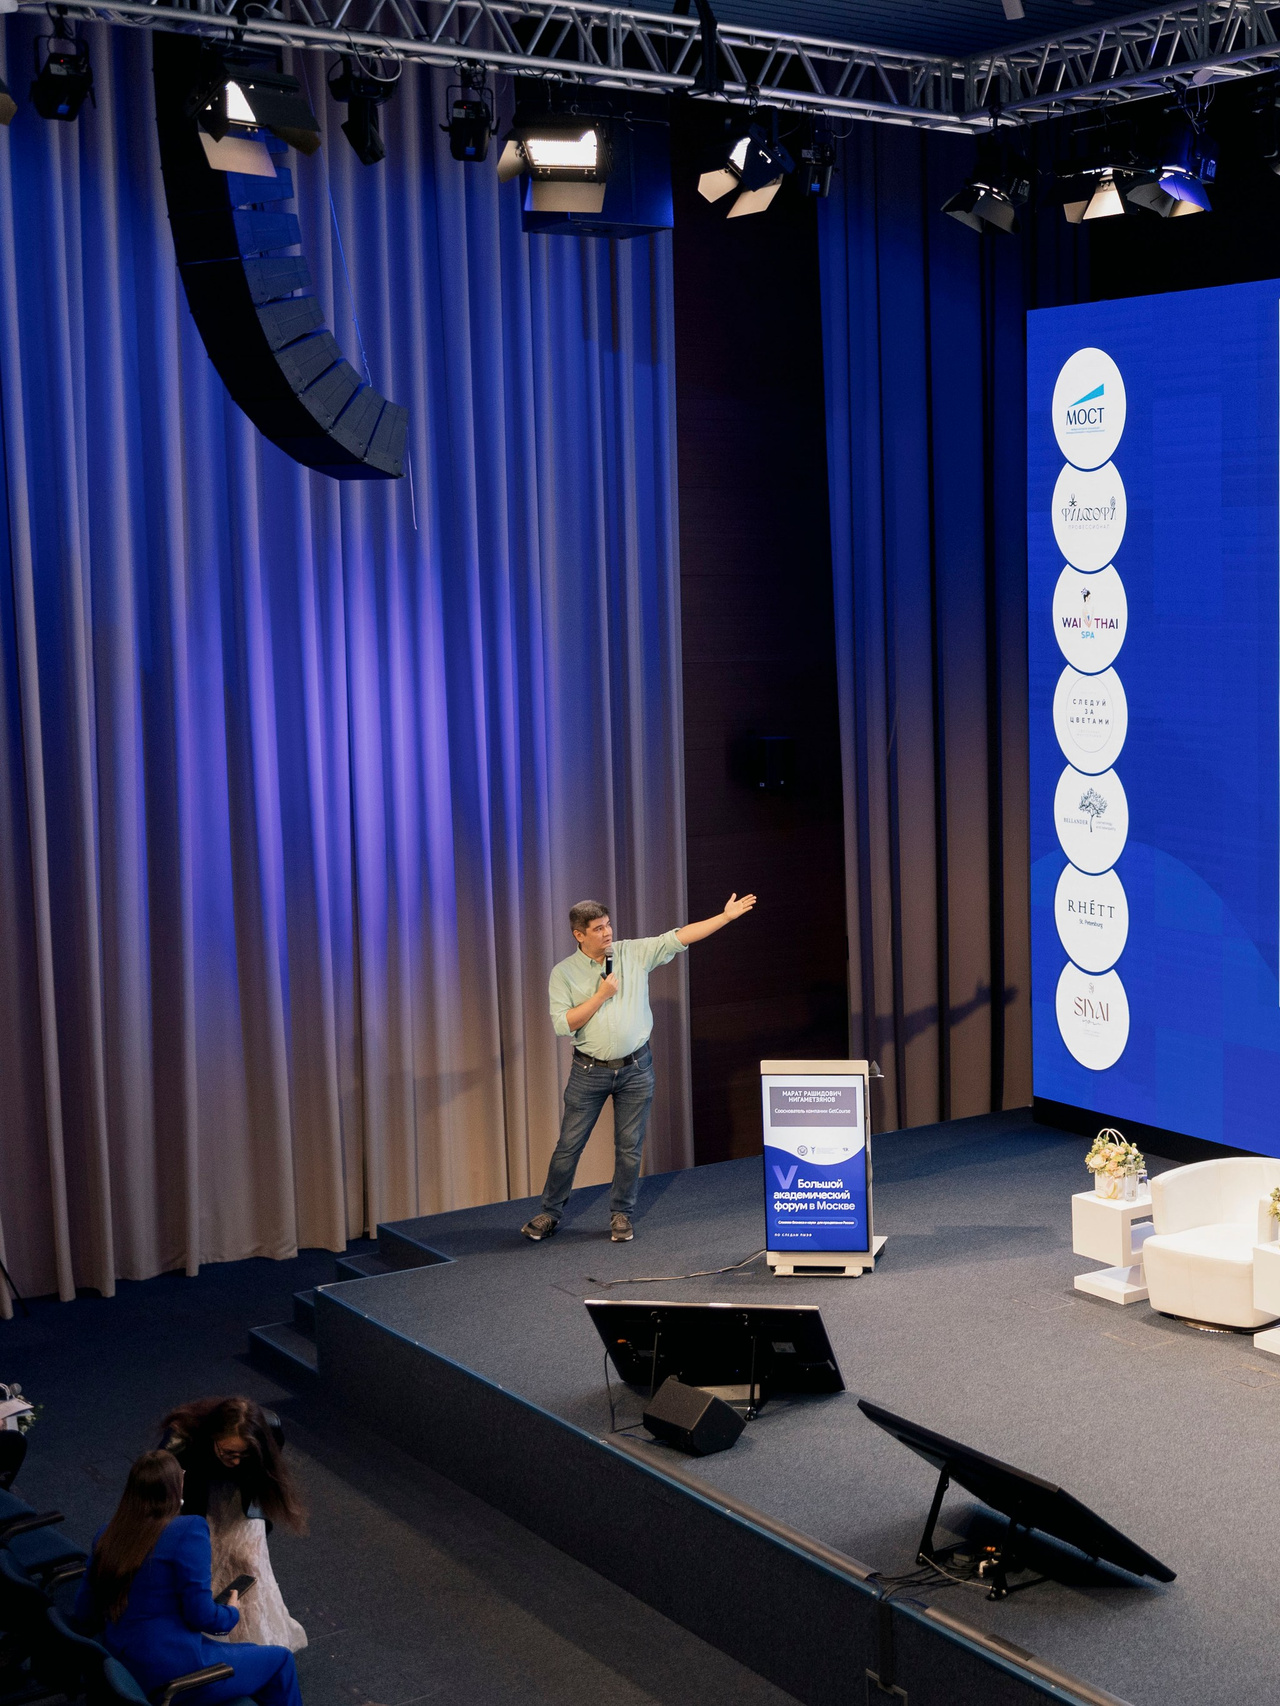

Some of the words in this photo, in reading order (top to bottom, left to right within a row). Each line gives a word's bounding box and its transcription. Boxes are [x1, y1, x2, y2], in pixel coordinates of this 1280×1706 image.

[1066, 407, 1105, 426] МОСТ
[1062, 617, 1082, 628] WAI
[1094, 618, 1119, 629] THAI
[1081, 631, 1095, 639] SPA
[1072, 698, 1107, 706] СЛЕДУЙ
[1069, 716, 1110, 725] ЦВЕТАМИ
[1068, 899, 1115, 919] RHÉTT
[797, 1179, 843, 1189] Большой
[773, 1190, 851, 1201] академический
[773, 1201, 808, 1212] форум
[816, 1201, 856, 1211] Москве
